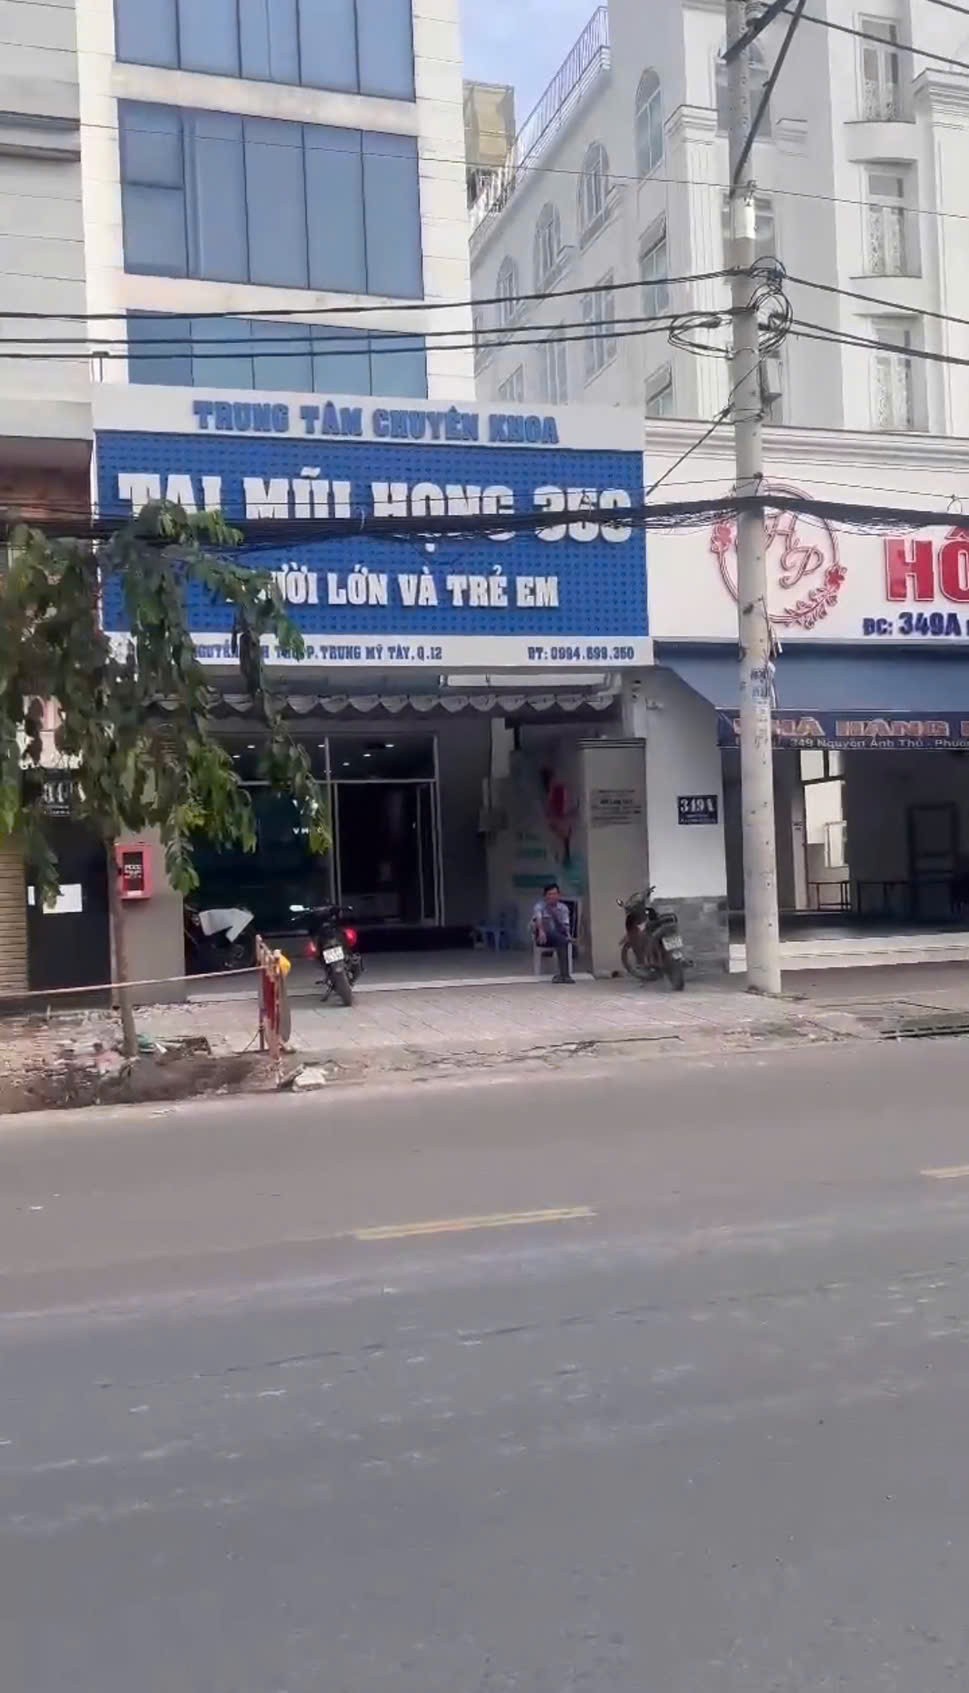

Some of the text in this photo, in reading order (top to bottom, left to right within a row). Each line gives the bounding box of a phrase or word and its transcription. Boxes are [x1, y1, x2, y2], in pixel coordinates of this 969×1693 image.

[193, 400, 559, 443] TRUNG TÂM CHUYÊN KHOA
[328, 563, 388, 605] LỚN
[398, 566, 438, 606] VÀ
[447, 565, 508, 607] TRẺ
[516, 576, 559, 607] EM
[862, 617, 893, 636] ĐC:
[898, 611, 962, 636] 349A
[366, 644, 383, 660] MỸ
